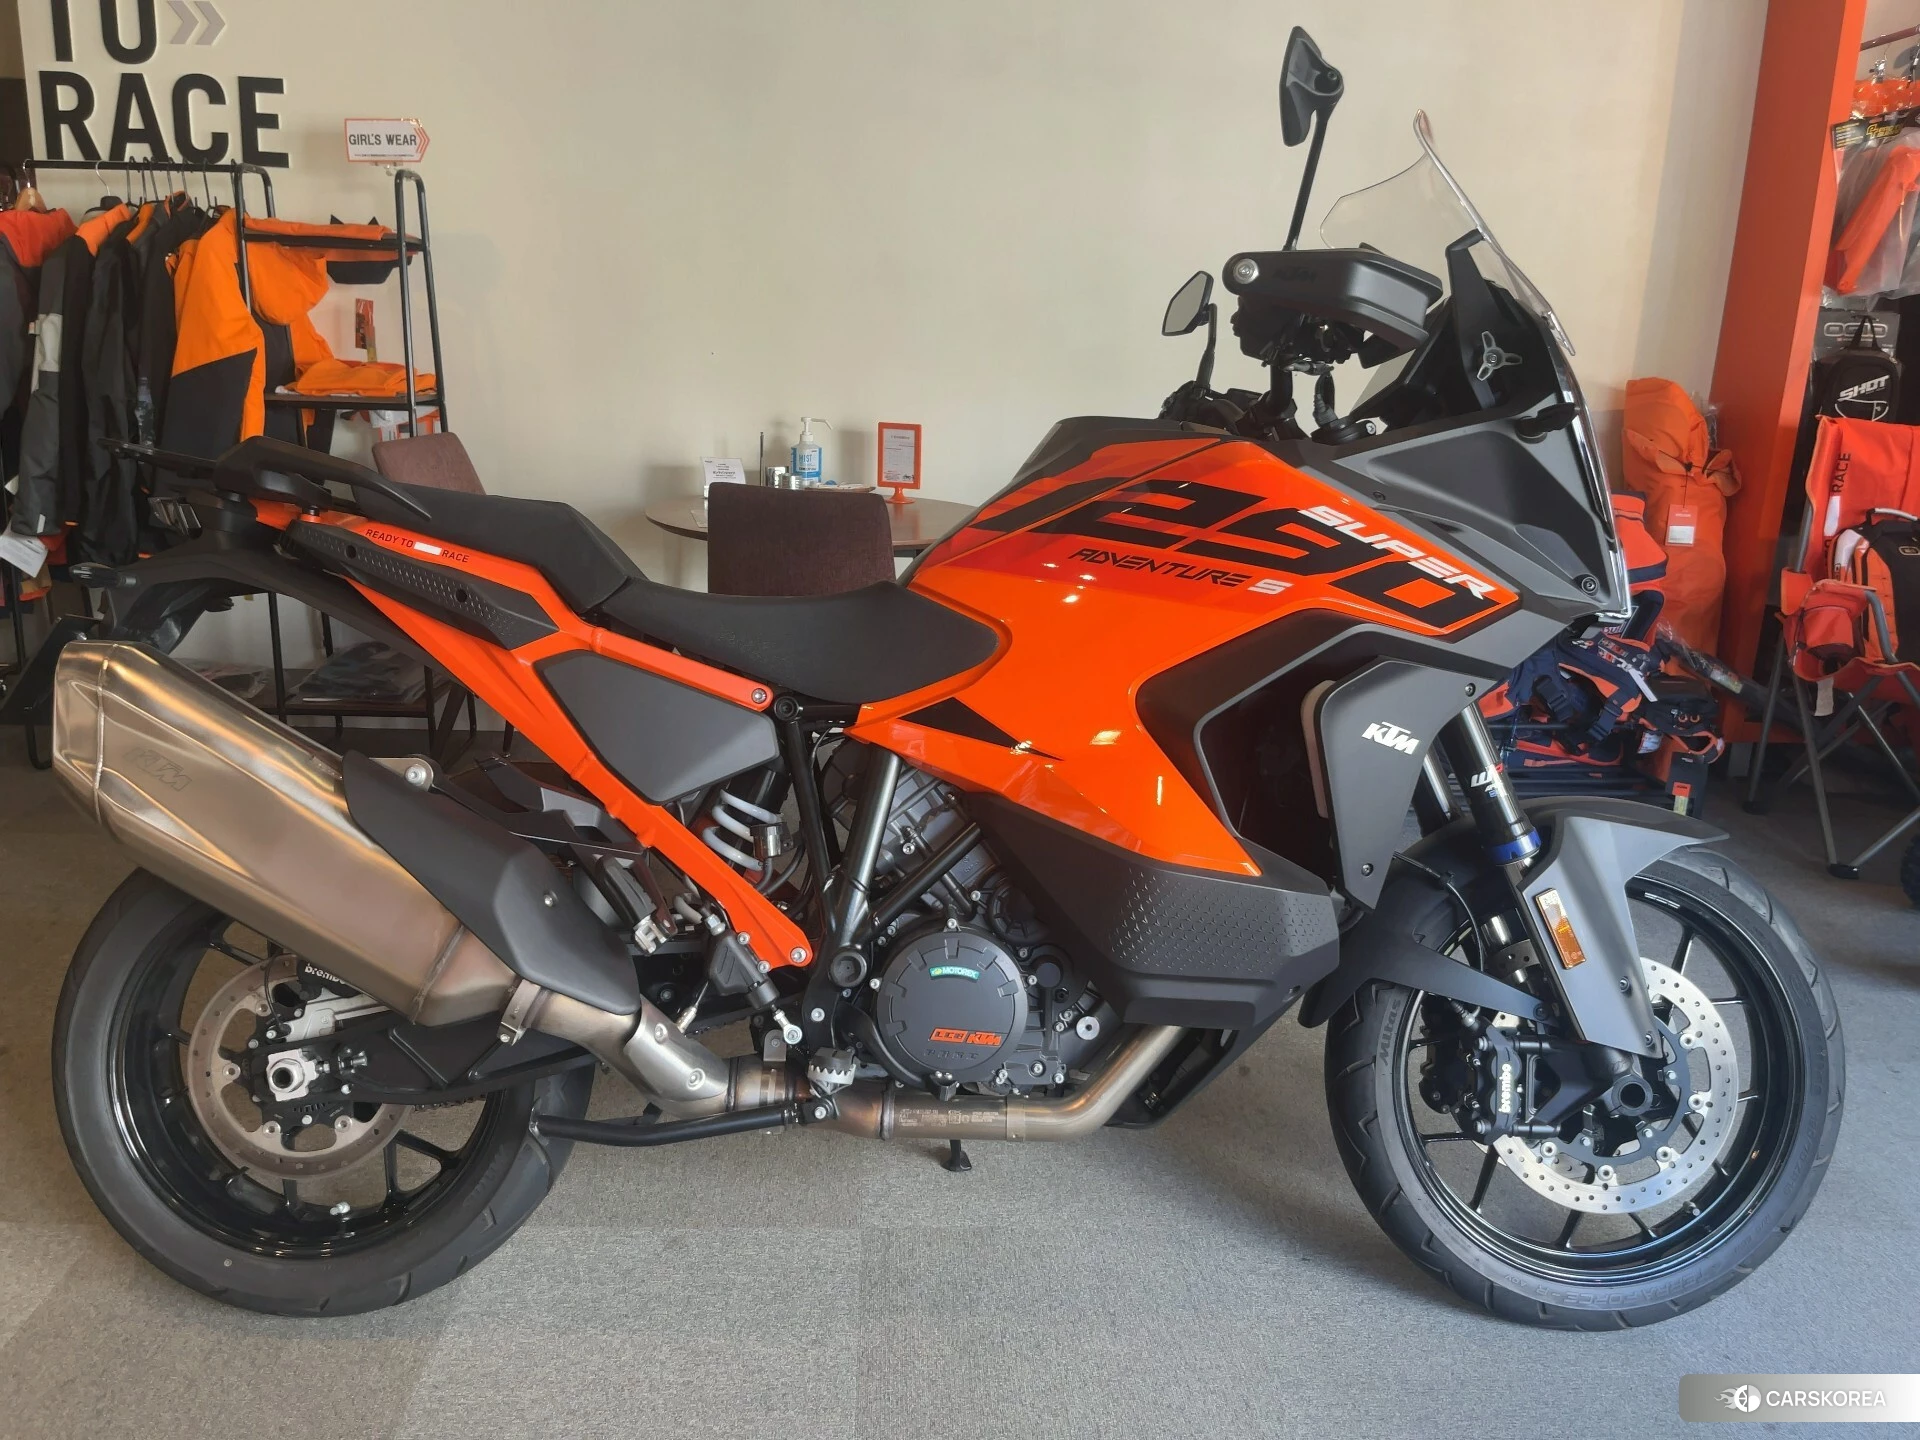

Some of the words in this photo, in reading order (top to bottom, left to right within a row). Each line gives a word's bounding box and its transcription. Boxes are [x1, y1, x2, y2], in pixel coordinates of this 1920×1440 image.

[39, 70, 289, 168] RACE
[348, 133, 382, 146] GIRL'S
[386, 134, 417, 146] WEAR
[1837, 374, 1890, 402] SHOT
[1832, 453, 1850, 493] RACE
[365, 529, 399, 543] READY
[401, 538, 414, 548] TO
[442, 549, 469, 563] RACE
[1297, 505, 1496, 600] SUPER
[1068, 548, 1253, 587] ADVENTURE
[1248, 579, 1294, 595] S
[1361, 721, 1420, 755] KTM
[942, 966, 977, 979] MOTOREX
[1498, 1063, 1512, 1113] brembo
